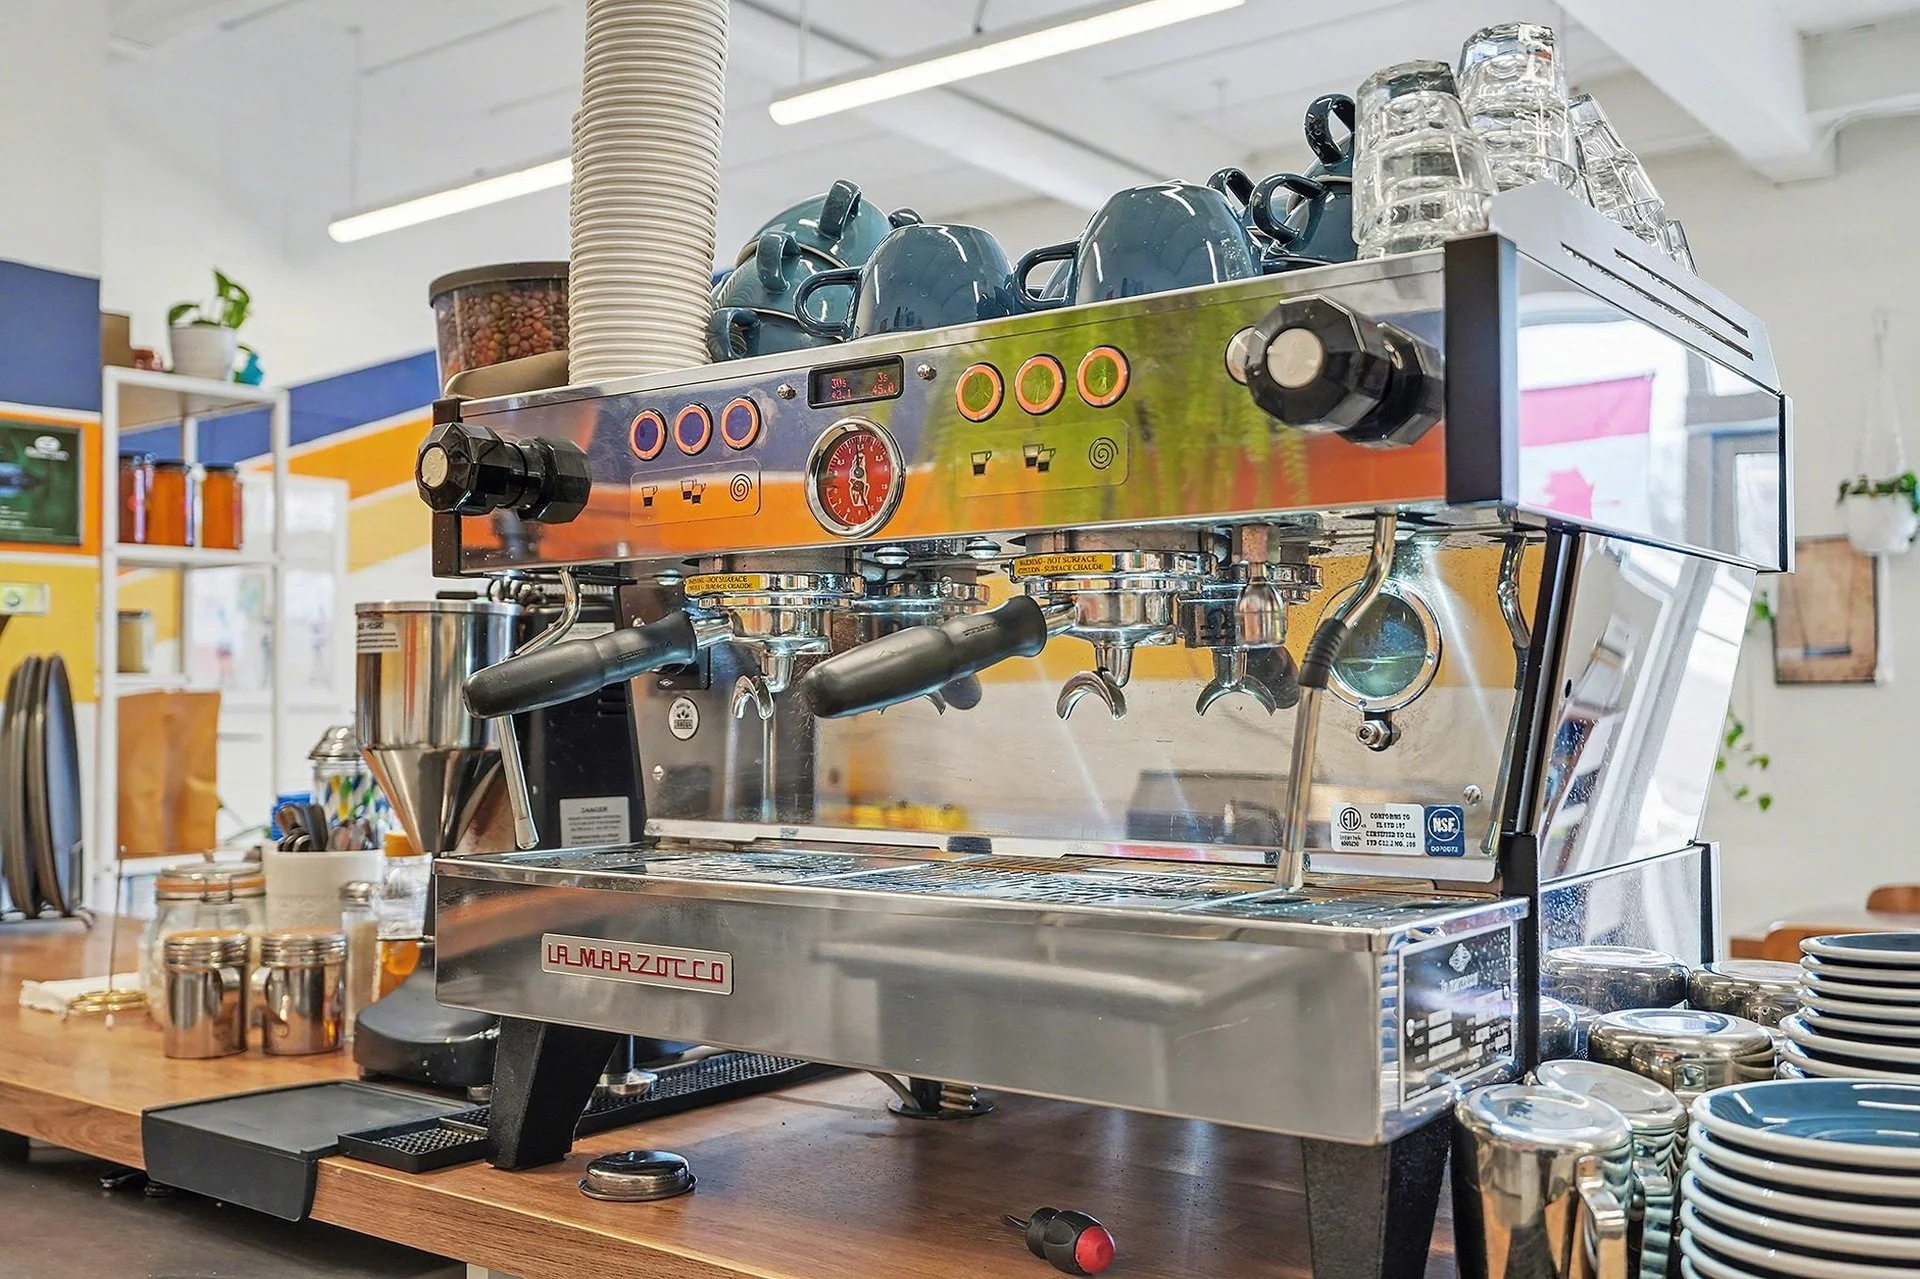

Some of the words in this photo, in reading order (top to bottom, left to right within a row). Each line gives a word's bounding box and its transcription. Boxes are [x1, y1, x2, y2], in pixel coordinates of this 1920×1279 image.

[1062, 555, 1097, 563] SURFACE
[1073, 563, 1103, 571] CHAUDE
[1370, 812, 1401, 820] CONFORMS
[1432, 817, 1456, 833] NSF
[548, 943, 568, 965] LA
